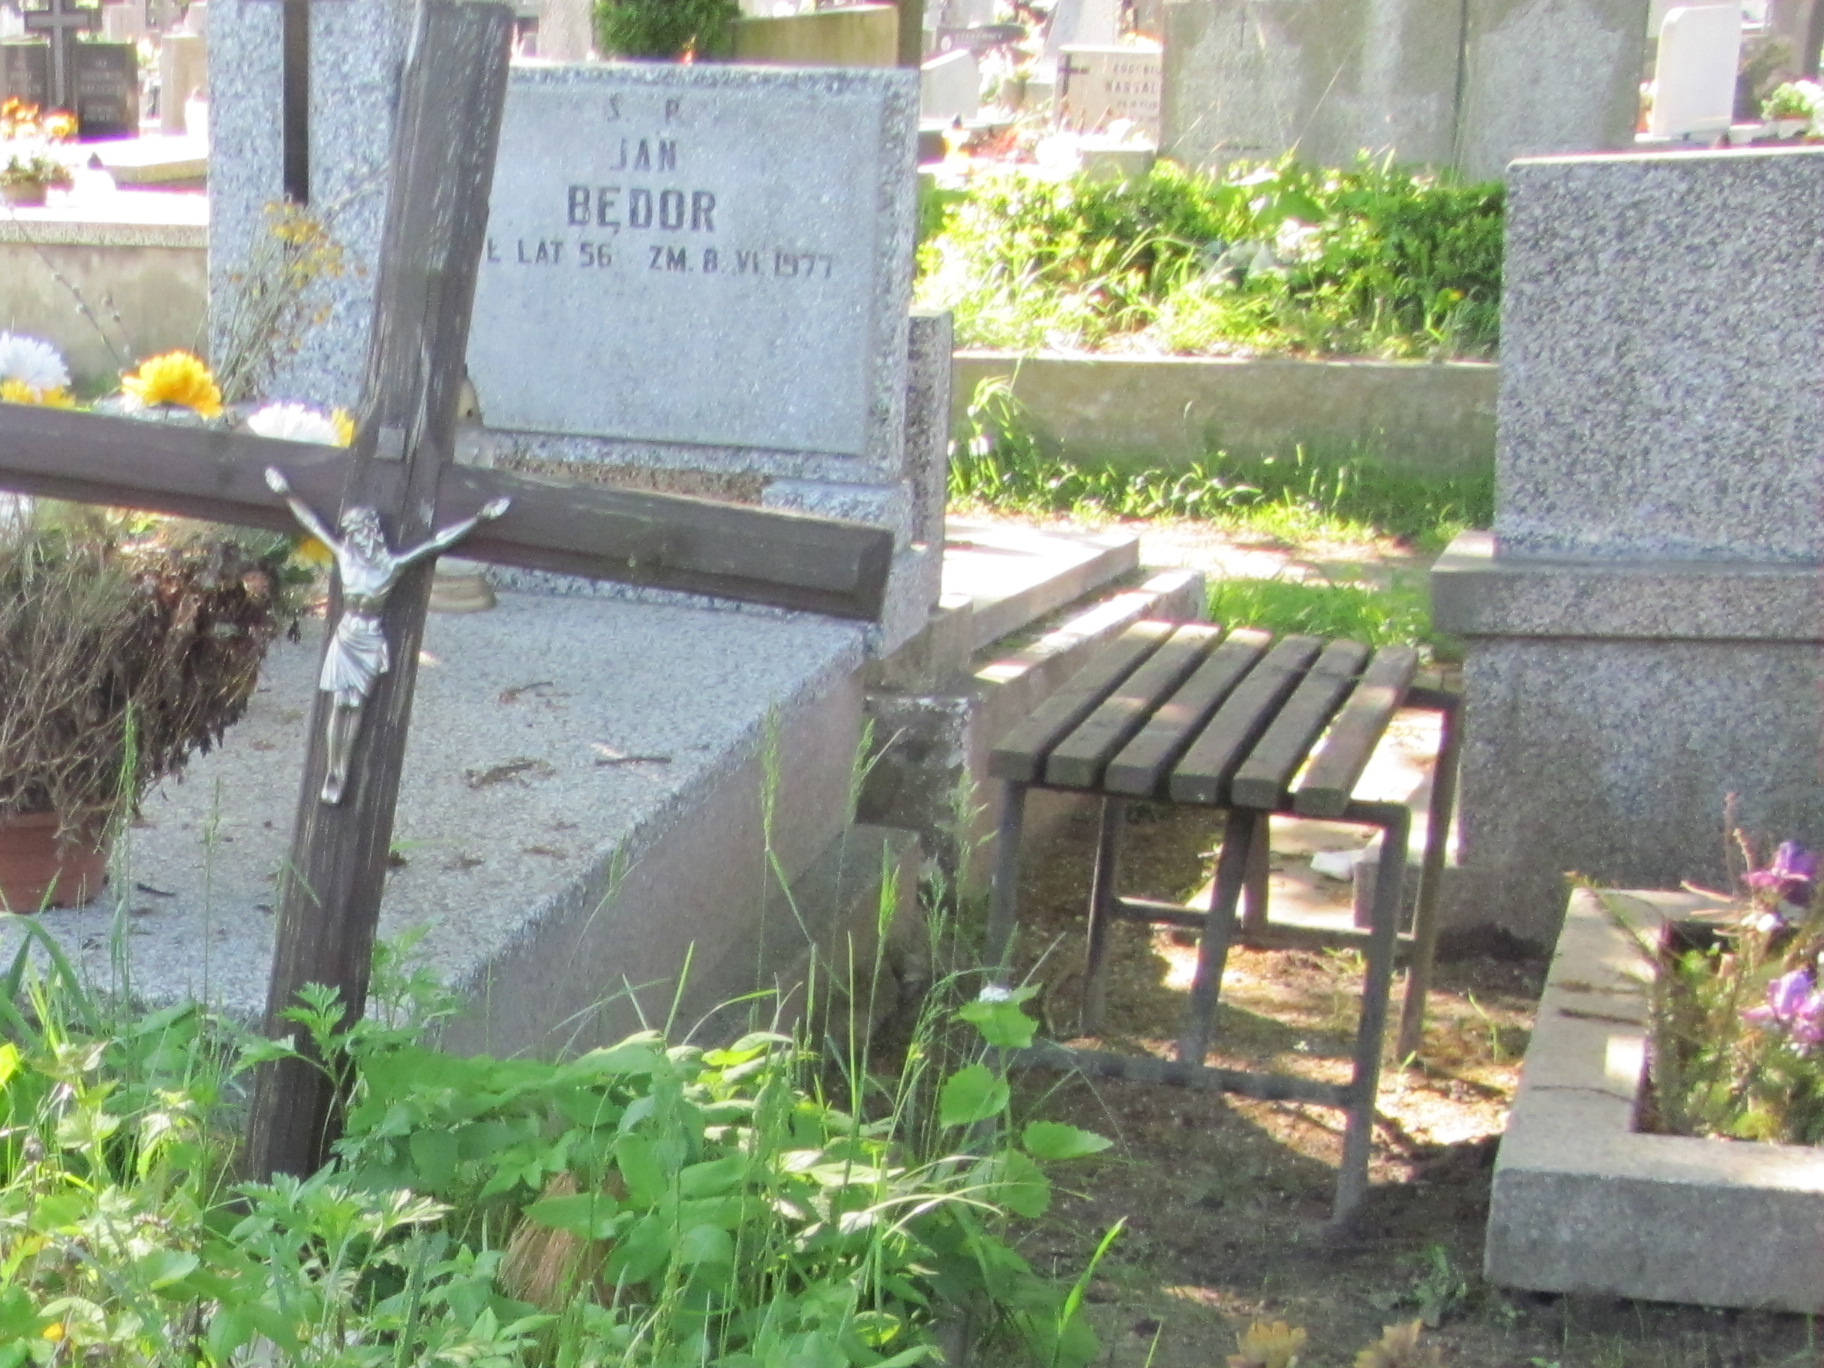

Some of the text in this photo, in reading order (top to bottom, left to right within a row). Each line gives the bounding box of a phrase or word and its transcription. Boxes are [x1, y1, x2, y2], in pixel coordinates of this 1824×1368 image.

[609, 137, 677, 174] JAN
[567, 184, 718, 236] BĘDOR
[517, 238, 564, 266] LAT
[579, 243, 613, 268] 56
